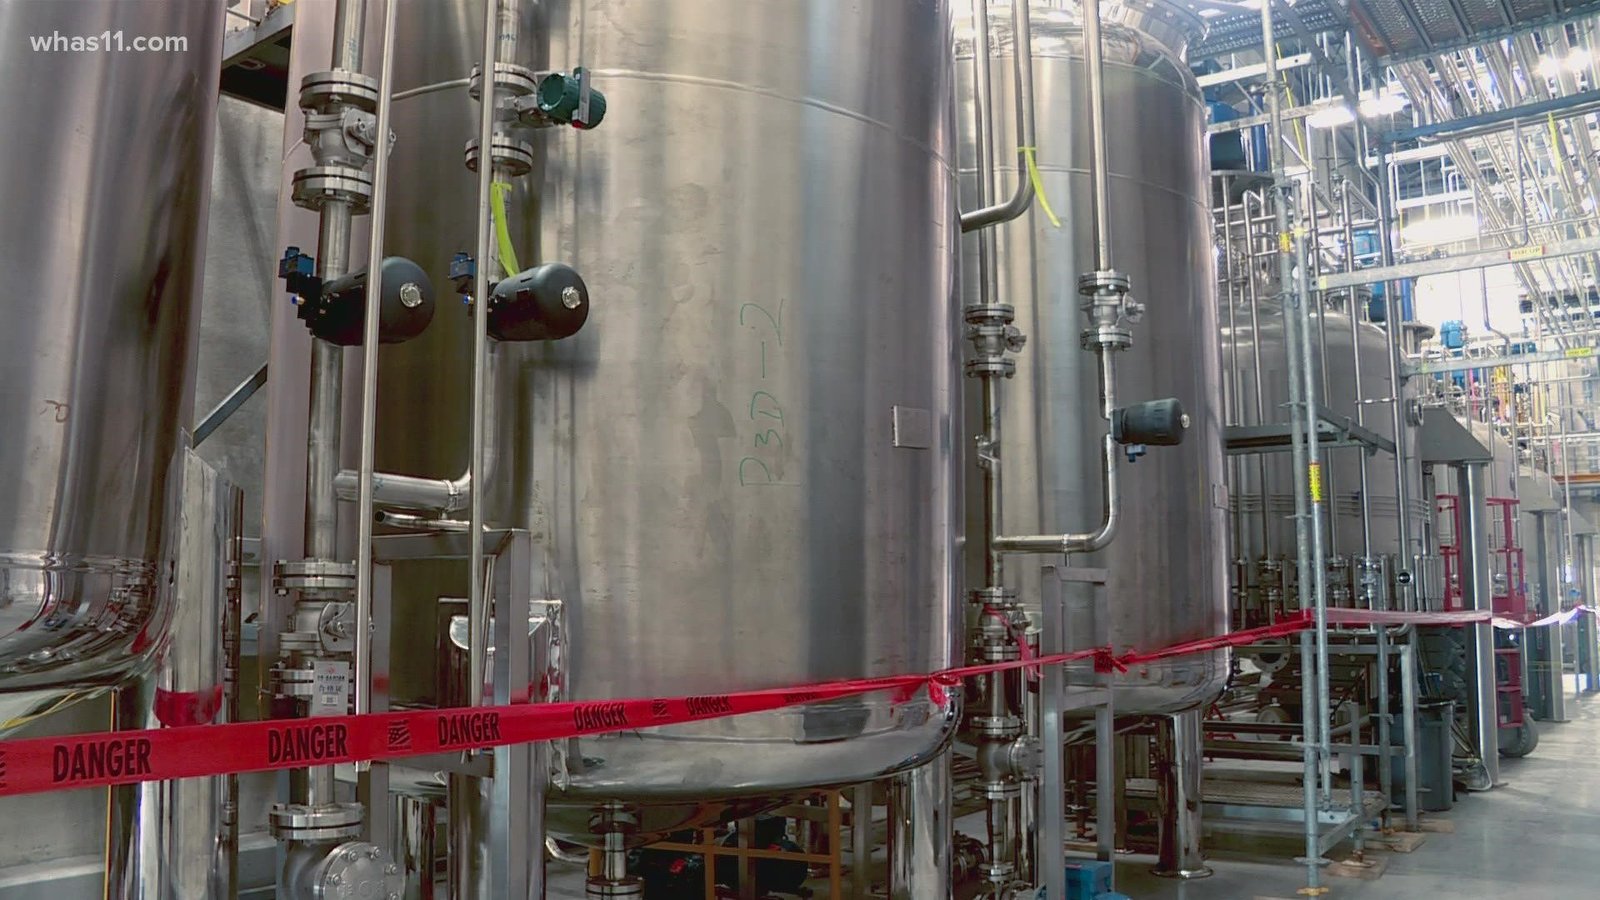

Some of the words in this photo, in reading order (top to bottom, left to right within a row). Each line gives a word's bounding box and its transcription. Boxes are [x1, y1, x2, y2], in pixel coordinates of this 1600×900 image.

[52, 738, 151, 783] DANGER
[267, 724, 348, 764] DANGER
[438, 711, 501, 746] DANGER
[573, 702, 629, 732] DANGER
